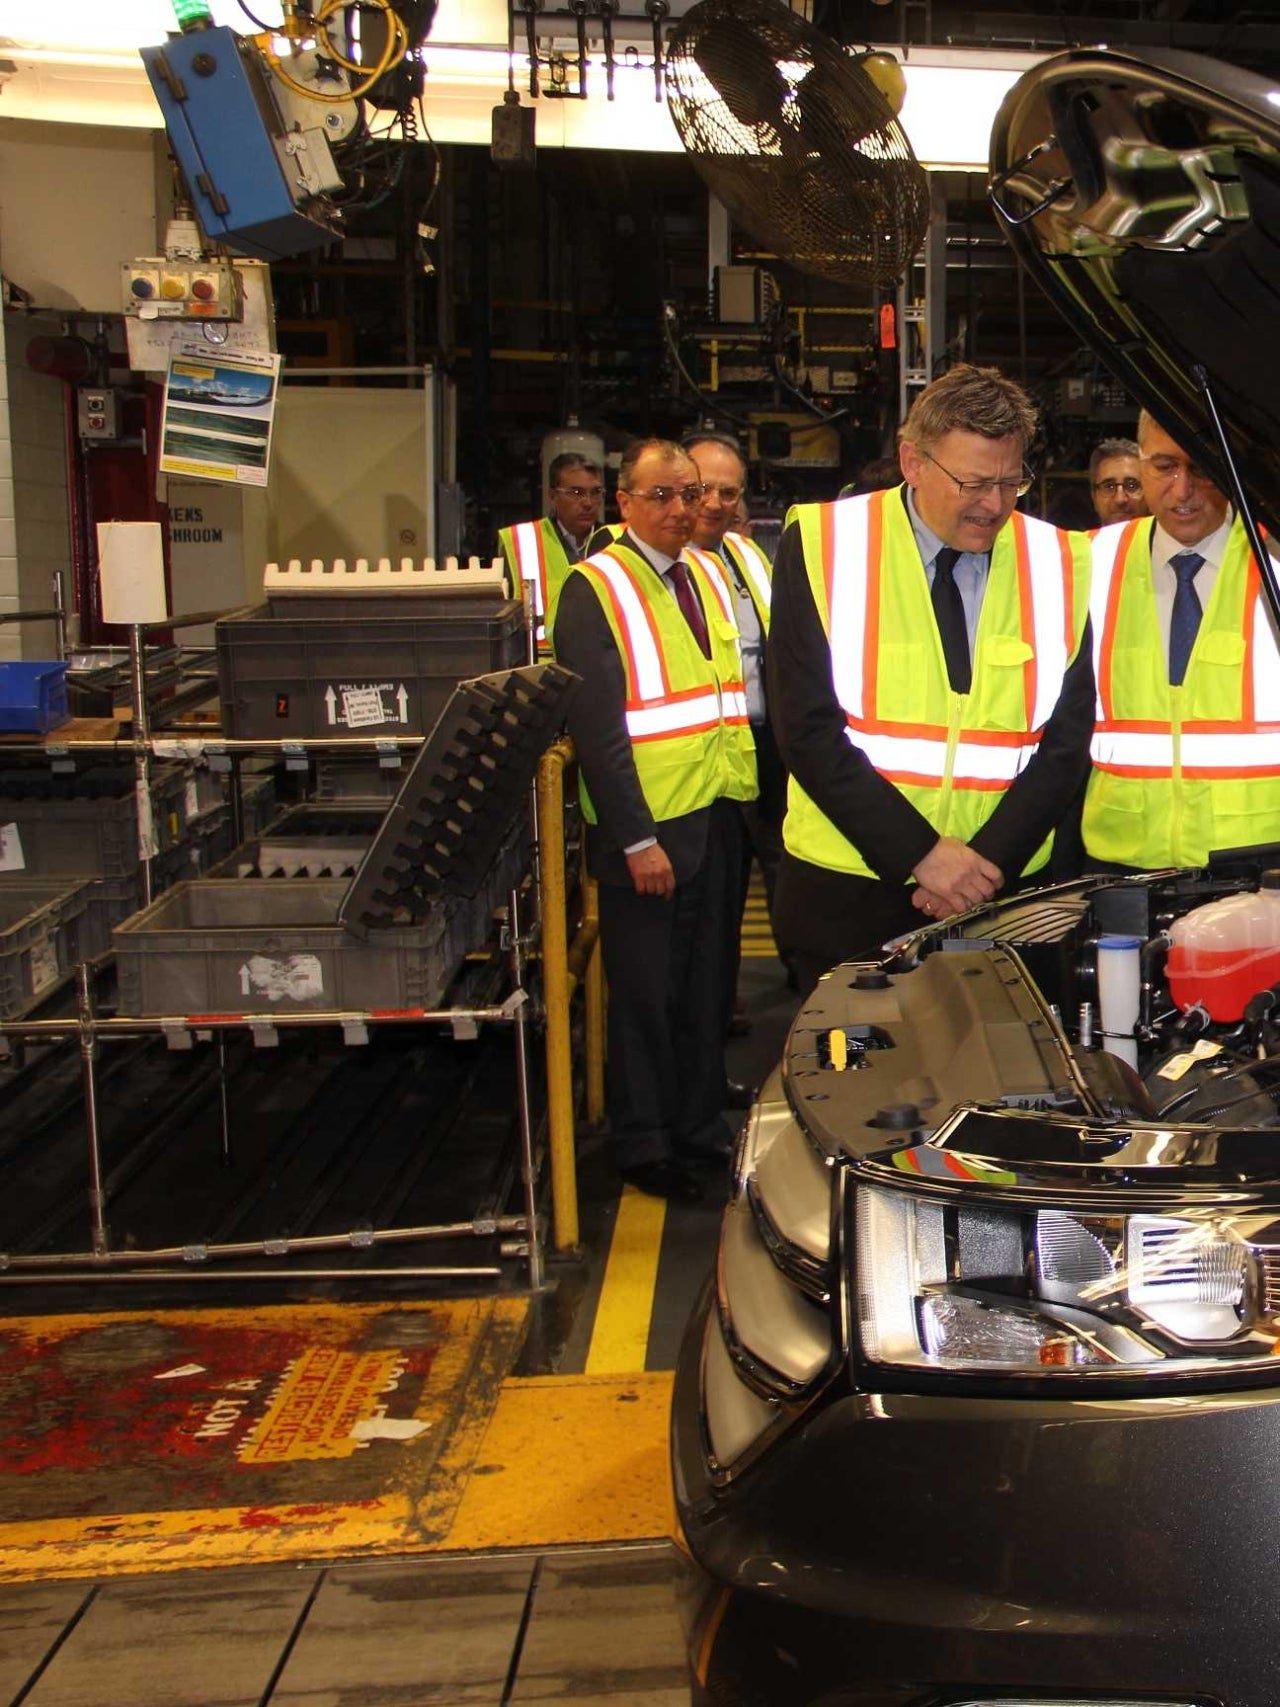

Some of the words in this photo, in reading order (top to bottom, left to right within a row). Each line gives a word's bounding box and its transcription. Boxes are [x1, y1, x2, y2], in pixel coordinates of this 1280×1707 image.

[169, 528, 223, 543] HROOM
[194, 1398, 249, 1435] NOT
[224, 1379, 262, 1391] A
[253, 1381, 325, 1458] RESTRICTED
[329, 1386, 371, 1439] OPERATOR
[357, 1358, 385, 1382] ONLY
[299, 1427, 325, 1442] NO
